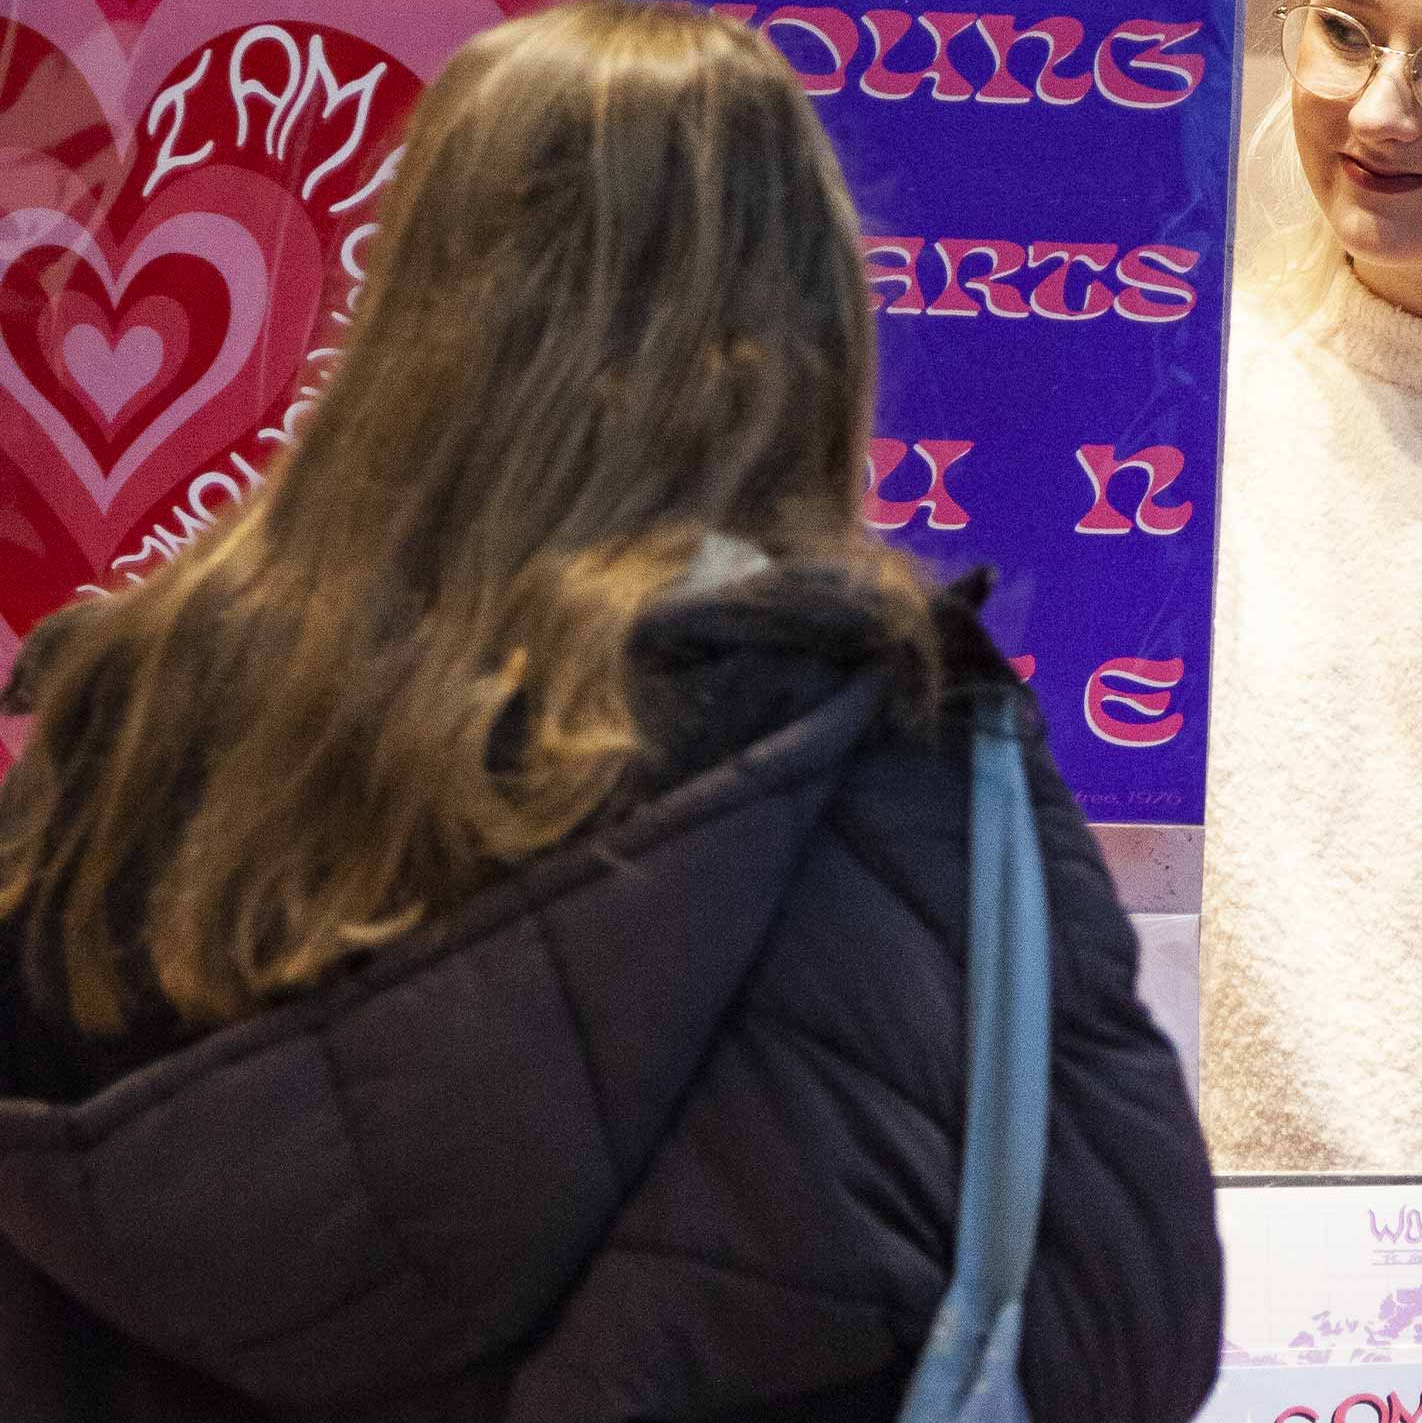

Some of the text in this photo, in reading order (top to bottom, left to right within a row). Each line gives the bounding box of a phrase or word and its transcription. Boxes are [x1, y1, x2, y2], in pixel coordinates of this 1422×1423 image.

[709, 2, 1206, 111] OUNG
[142, 24, 388, 201] I AM
[865, 235, 1200, 323] ARTS
